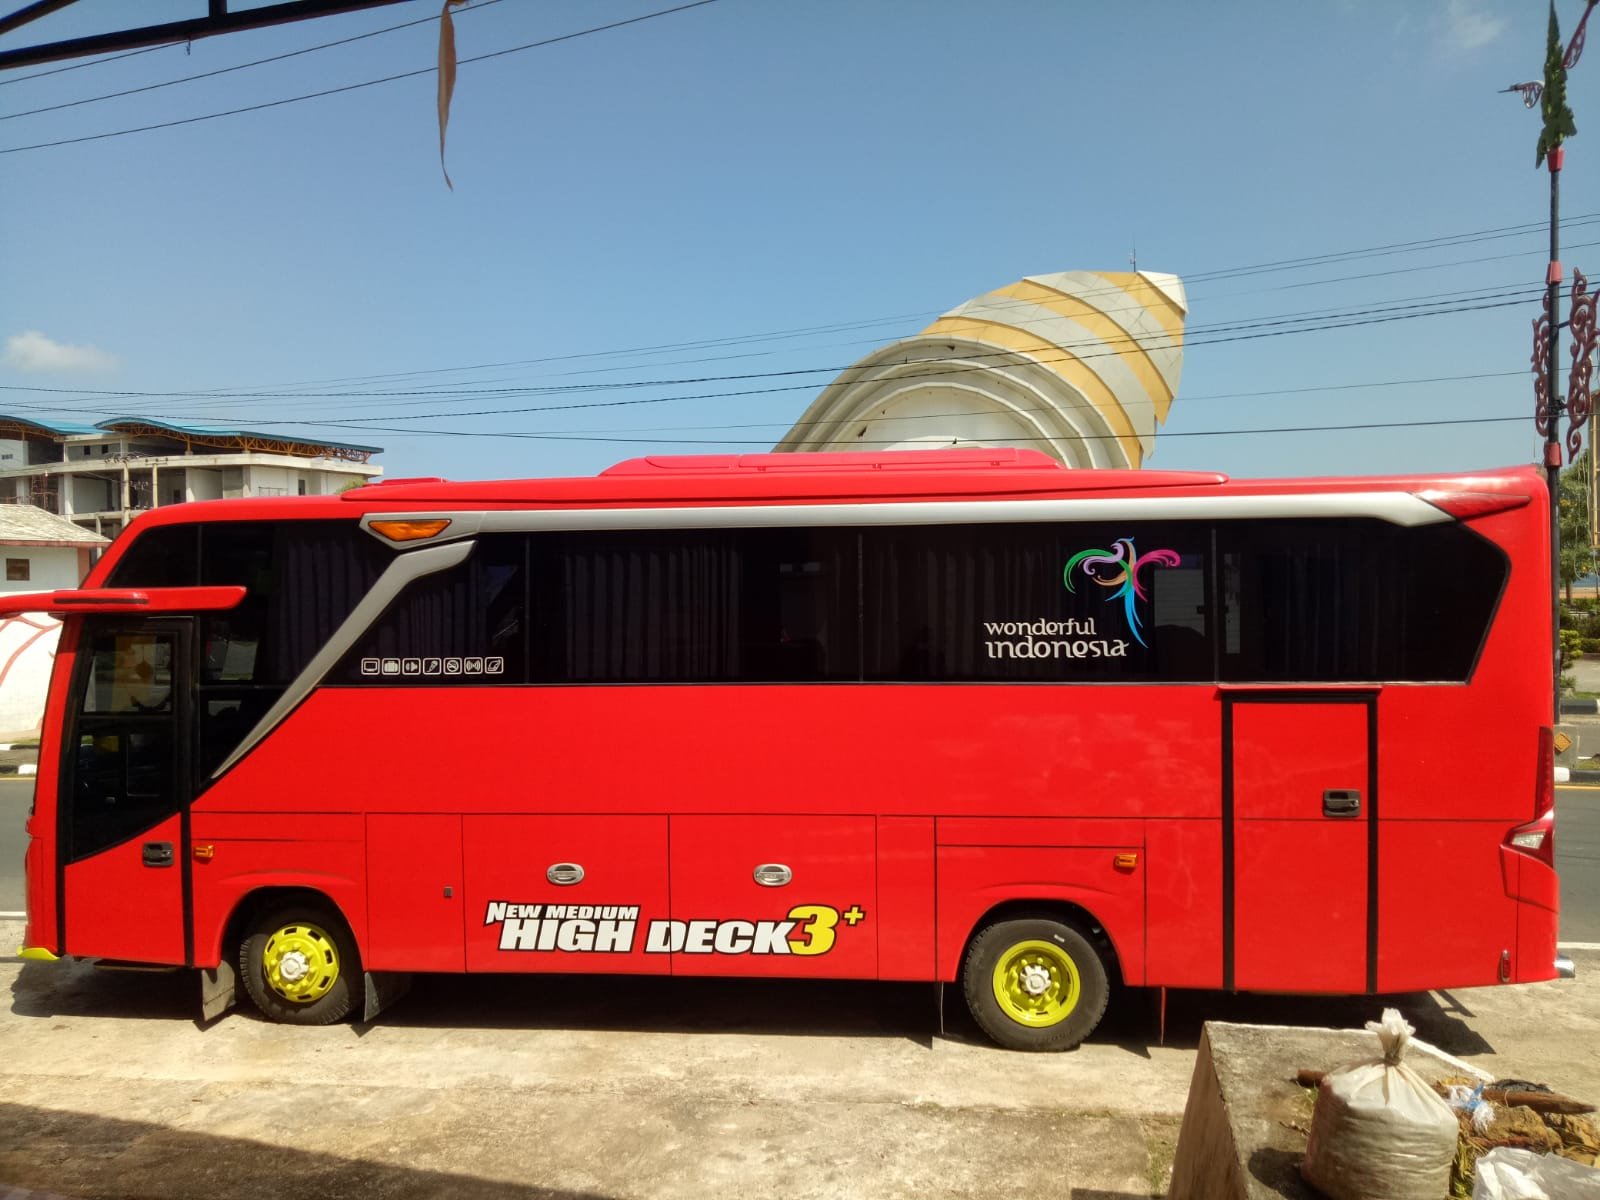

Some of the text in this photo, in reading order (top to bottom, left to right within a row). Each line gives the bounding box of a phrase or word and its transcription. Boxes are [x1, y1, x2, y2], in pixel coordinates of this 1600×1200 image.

[984, 617, 1097, 636] wonderful
[985, 635, 1130, 659] indonesia
[486, 902, 640, 924] NEW MEDIUM
[498, 918, 636, 953] HIGH
